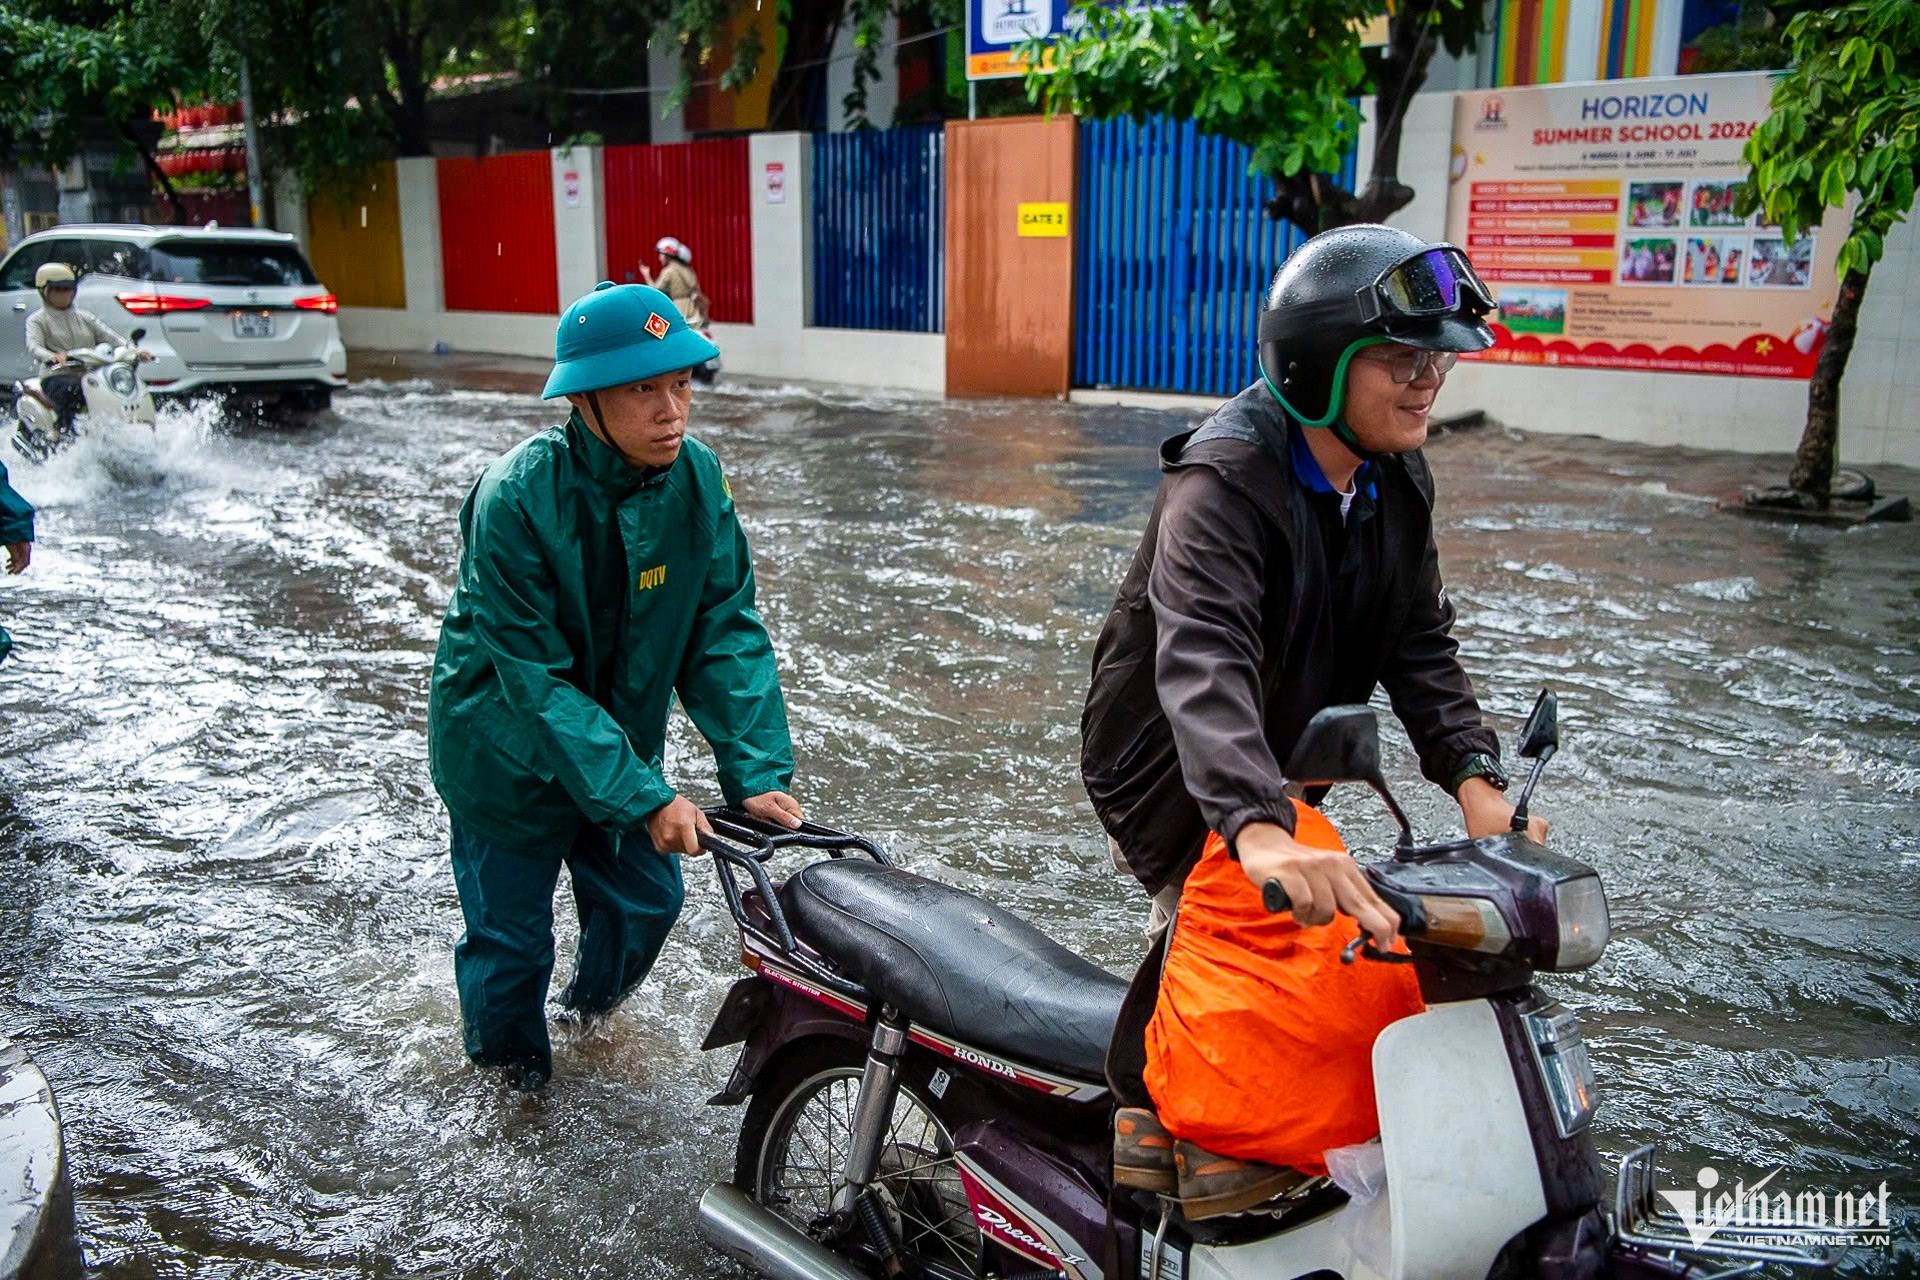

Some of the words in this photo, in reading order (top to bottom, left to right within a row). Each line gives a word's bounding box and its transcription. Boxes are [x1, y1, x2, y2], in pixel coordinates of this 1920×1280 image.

[1581, 92, 1709, 120] HORIZON
[1532, 126, 1612, 146] SUMMER
[1618, 123, 1703, 143] SCHOOL
[1022, 213, 1053, 225] GATE
[764, 967, 793, 984] ELECTRIC
[792, 980, 821, 997] STARTER
[953, 1046, 1017, 1079] HONDA
[976, 1203, 1062, 1256] Dream
[1061, 1252, 1086, 1265] II
